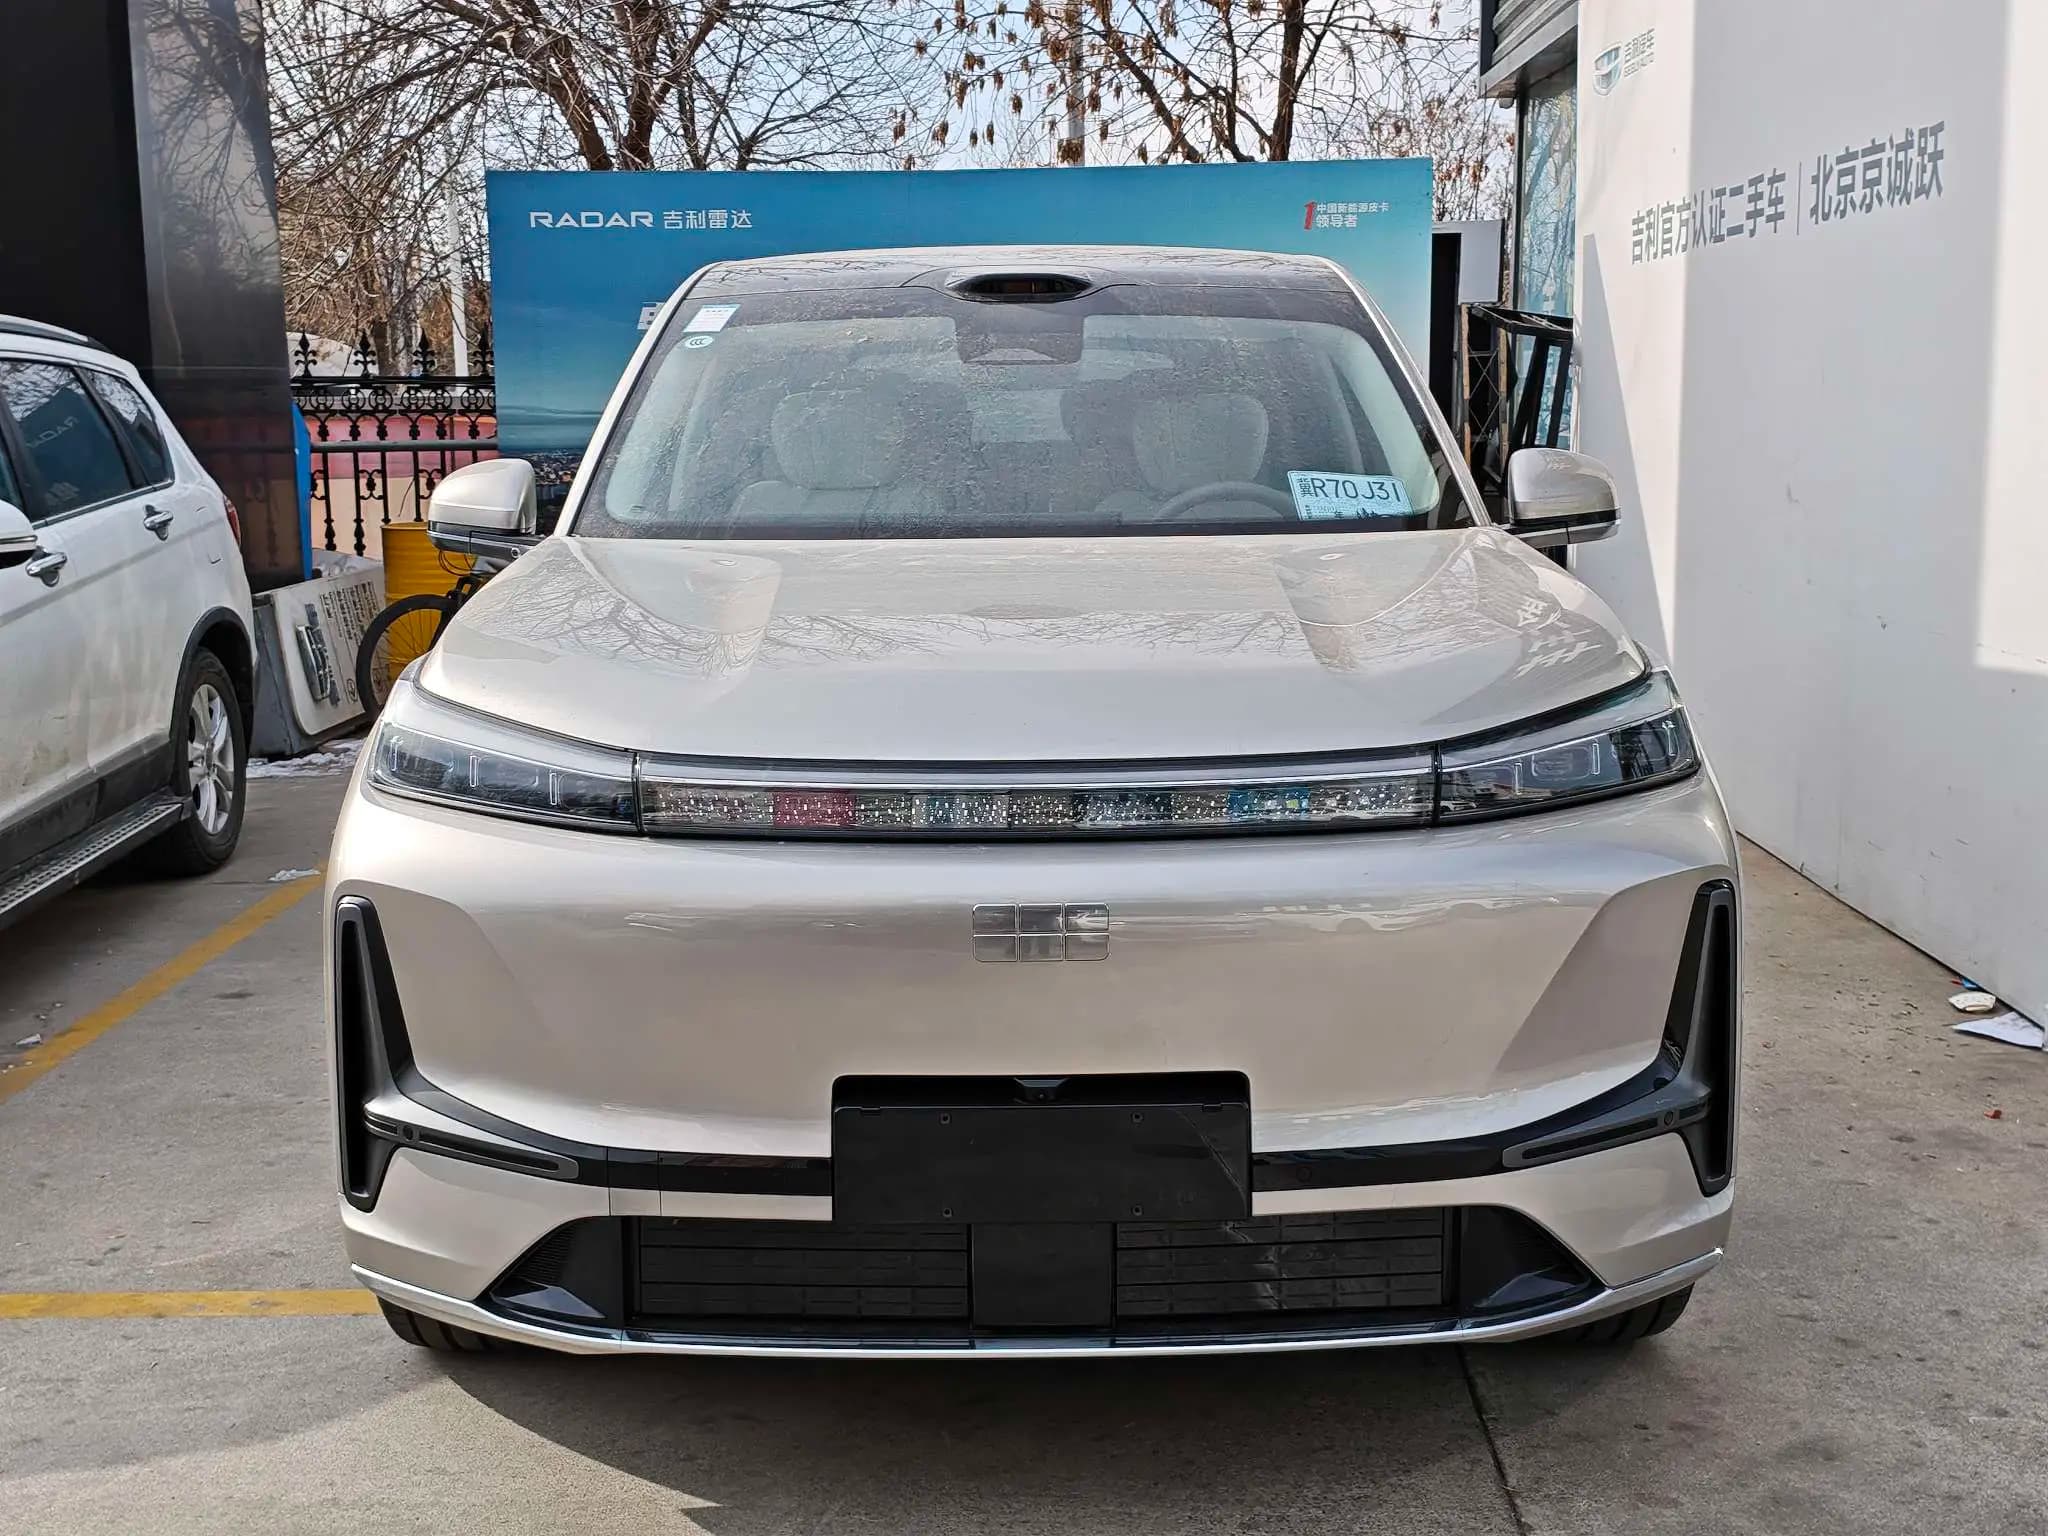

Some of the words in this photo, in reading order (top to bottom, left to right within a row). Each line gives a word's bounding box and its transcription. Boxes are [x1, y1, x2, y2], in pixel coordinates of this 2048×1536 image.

[1632, 168, 1786, 265] 吉利官方认证二手车
[1810, 120, 1945, 225] 北京京诚跃
[1316, 202, 1390, 213] 中国新能源皮卡
[528, 211, 655, 229] RADAR
[663, 209, 753, 230] 吉利雷达
[1316, 214, 1358, 228] 领导者
[1297, 477, 1402, 502] 冀R70J31
